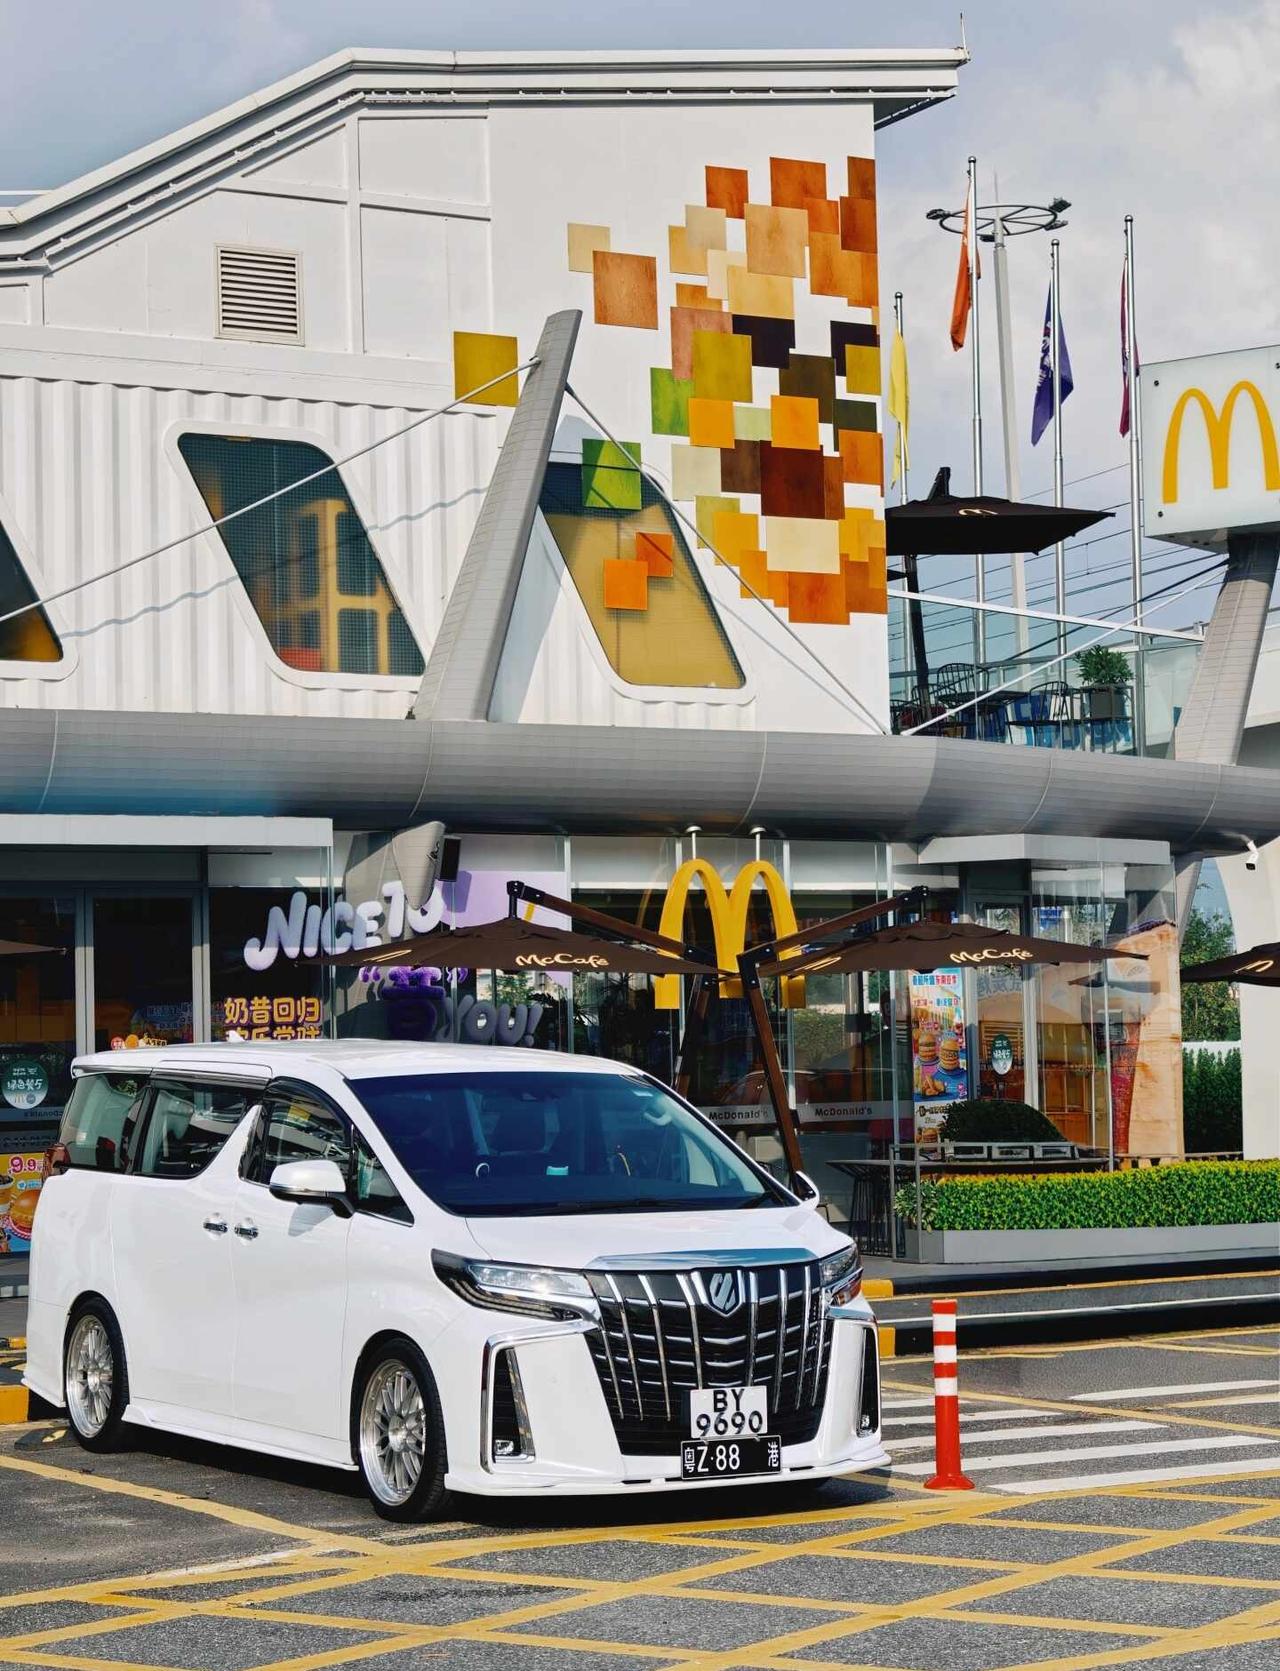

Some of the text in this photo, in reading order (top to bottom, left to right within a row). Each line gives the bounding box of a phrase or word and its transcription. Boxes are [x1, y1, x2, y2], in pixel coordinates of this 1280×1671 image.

[244, 890, 384, 972] NICE
[224, 995, 321, 1024] 奶昔回归
[708, 1109, 769, 1121] McDonald's
[814, 1105, 873, 1117] McDonald's
[713, 1388, 745, 1412] BY
[696, 1410, 763, 1436] 9690
